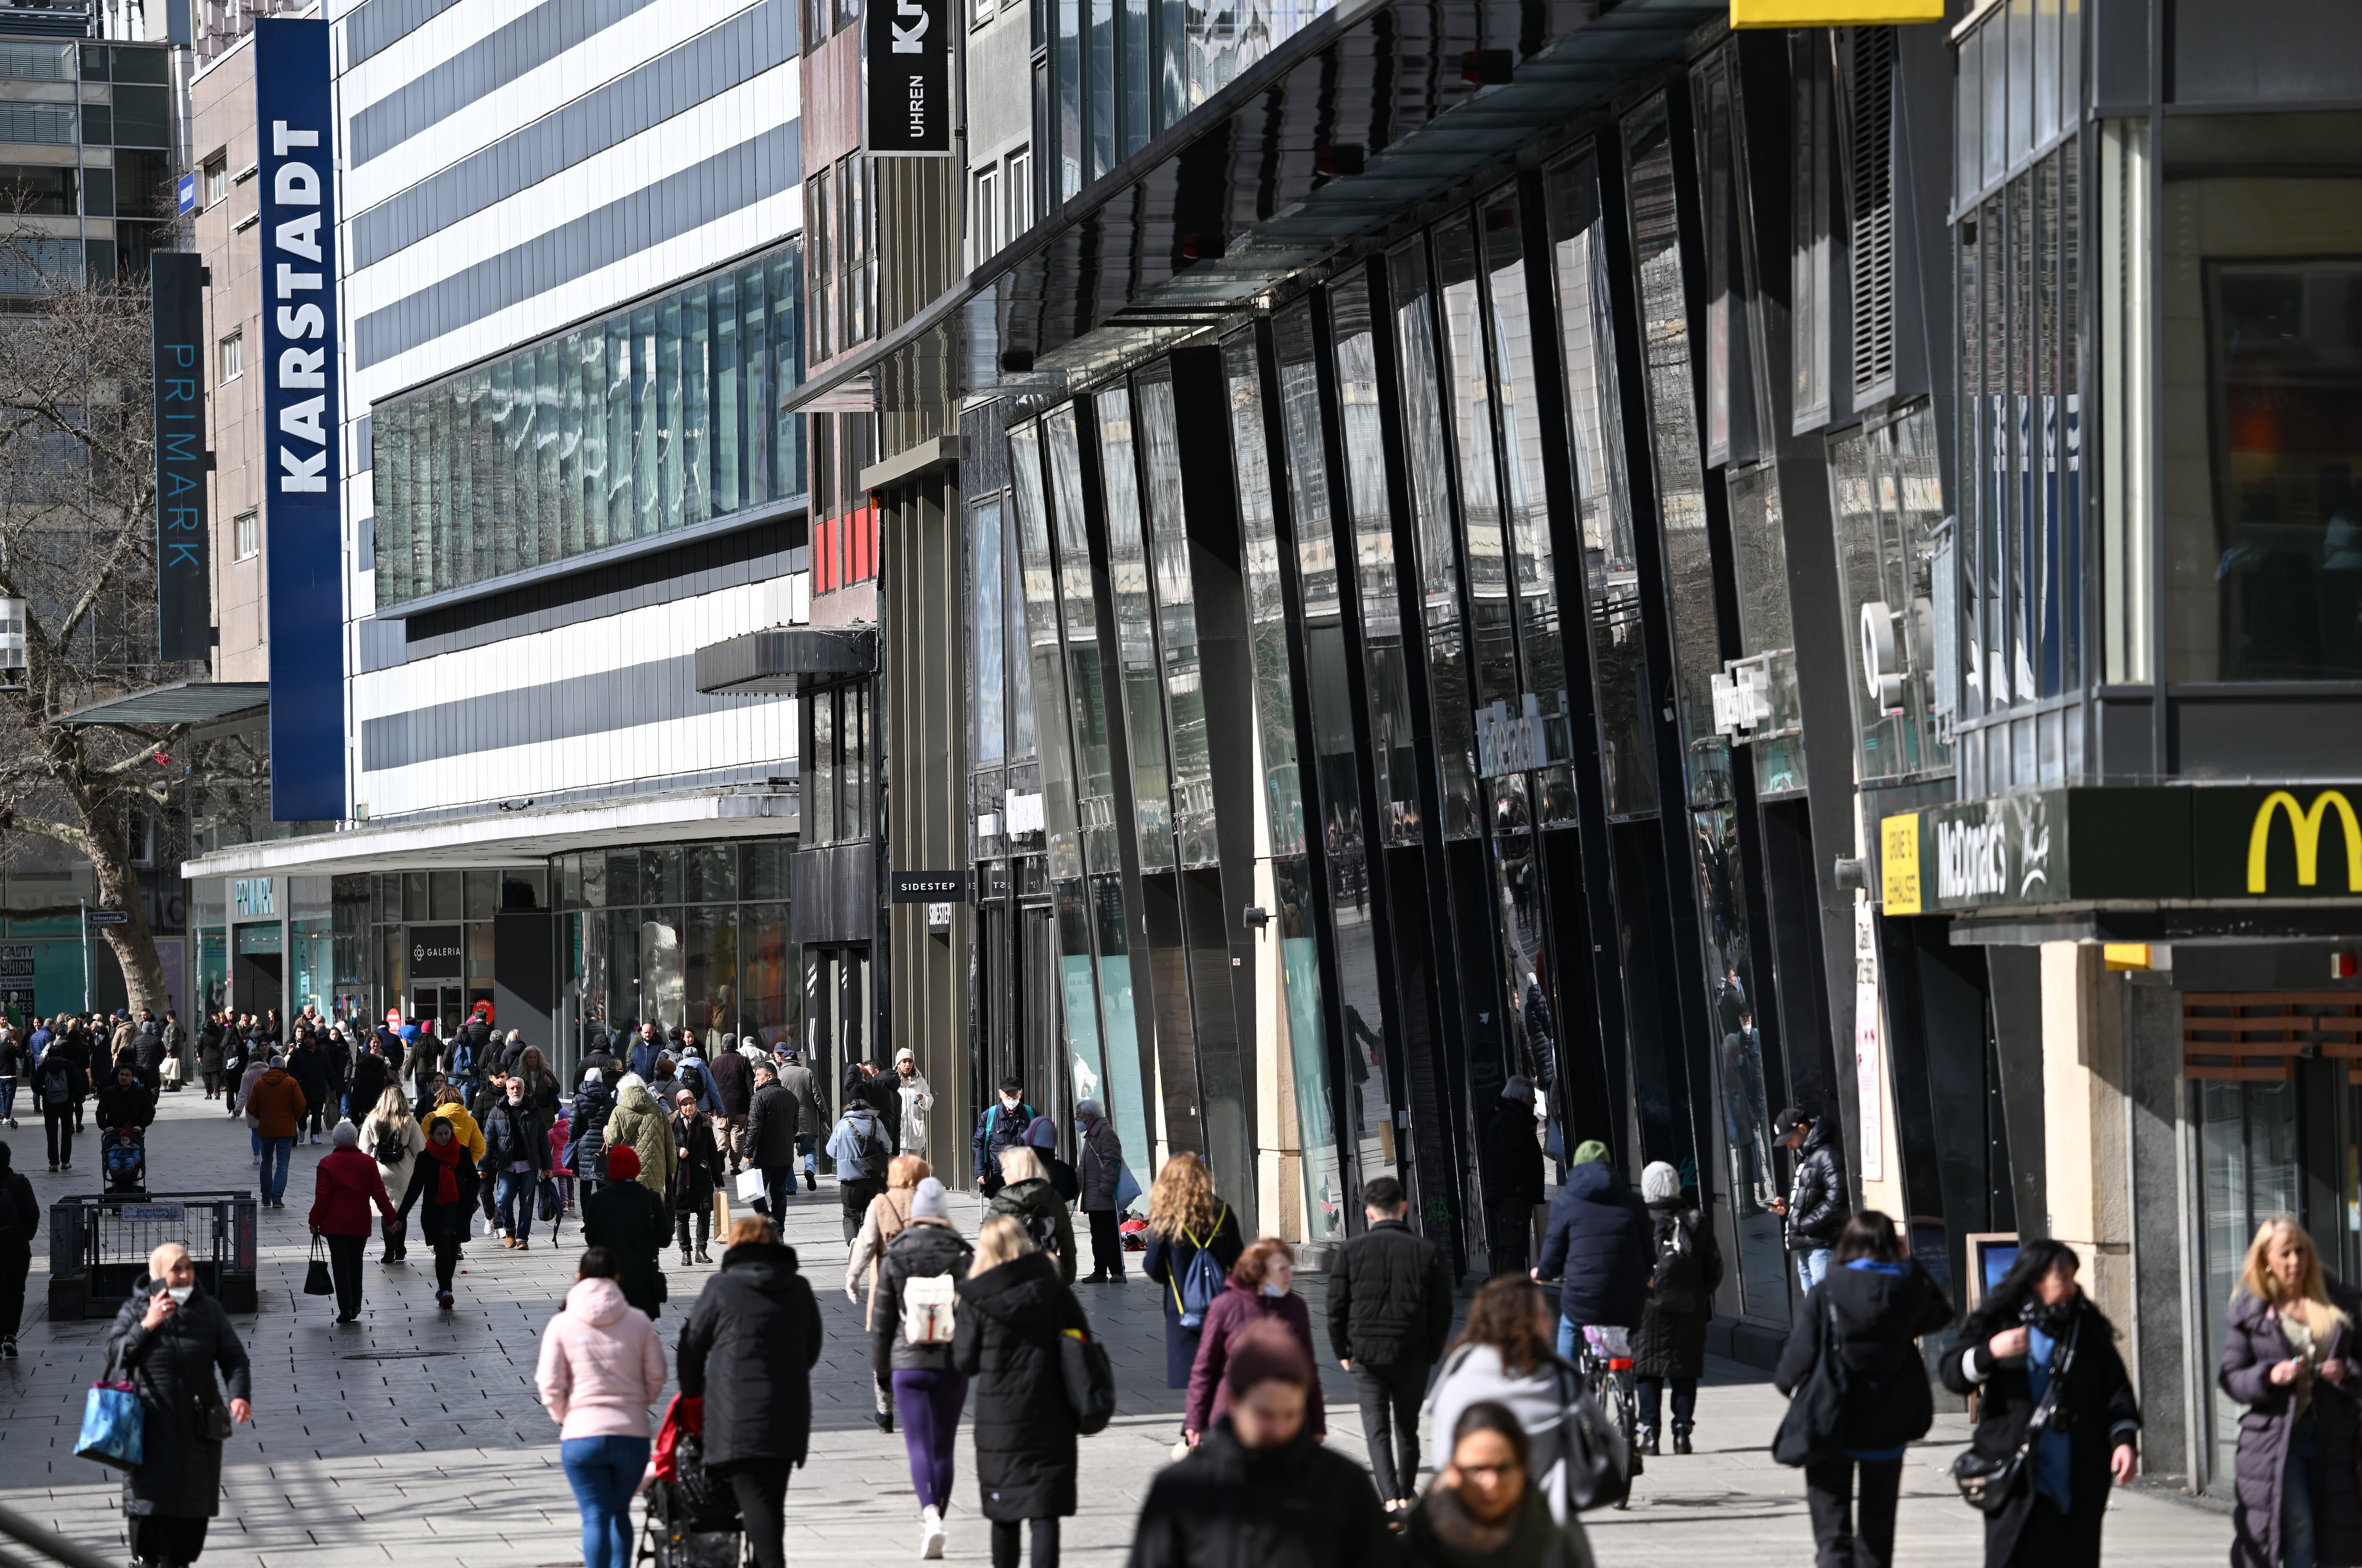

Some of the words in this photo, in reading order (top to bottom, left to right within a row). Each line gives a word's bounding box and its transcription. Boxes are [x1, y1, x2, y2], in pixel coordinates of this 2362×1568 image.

[910, 76, 924, 137] UHREN
[274, 120, 327, 492] KARSTADT
[164, 345, 199, 567] PRIMARK
[236, 877, 273, 916] PRIMARK
[901, 883, 955, 891] SIDESTEP
[929, 903, 950, 925] SIDESTEP
[427, 948, 461, 956] GALERIA
[19, 991, 33, 1001] ALL
